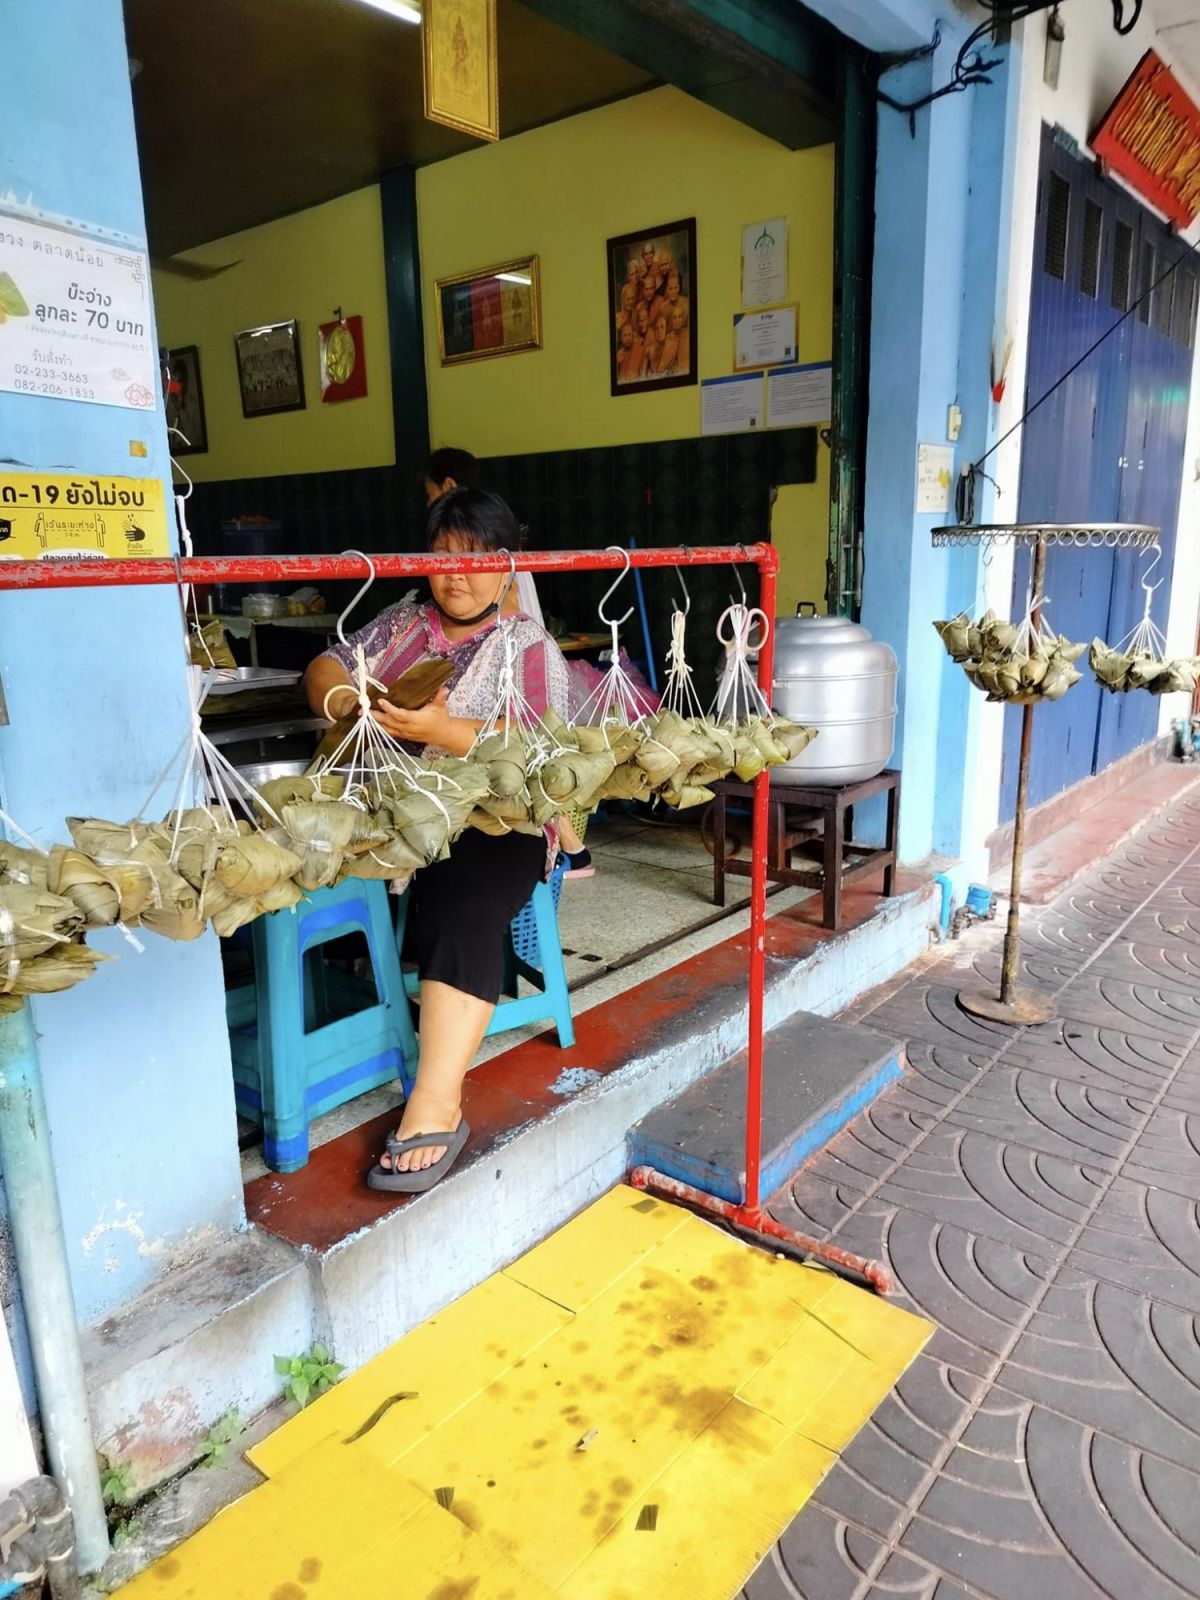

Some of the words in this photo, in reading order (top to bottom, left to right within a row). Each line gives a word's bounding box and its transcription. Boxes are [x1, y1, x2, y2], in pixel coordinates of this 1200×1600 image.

[33, 239, 104, 268] ตลาดน้อย
[68, 282, 112, 307] บ๊ะจ่าง
[35, 303, 78, 323] ลูกละ
[86, 309, 109, 329] 70
[116, 320, 144, 337] บาท
[33, 348, 73, 367] รับสั่งทำ
[14, 364, 88, 384] 02-233-3663
[14, 379, 95, 399] 082-206-1833
[66, 480, 144, 506] ยังไม่จบ
[46, 519, 94, 529] เว้นระยะห่าง
